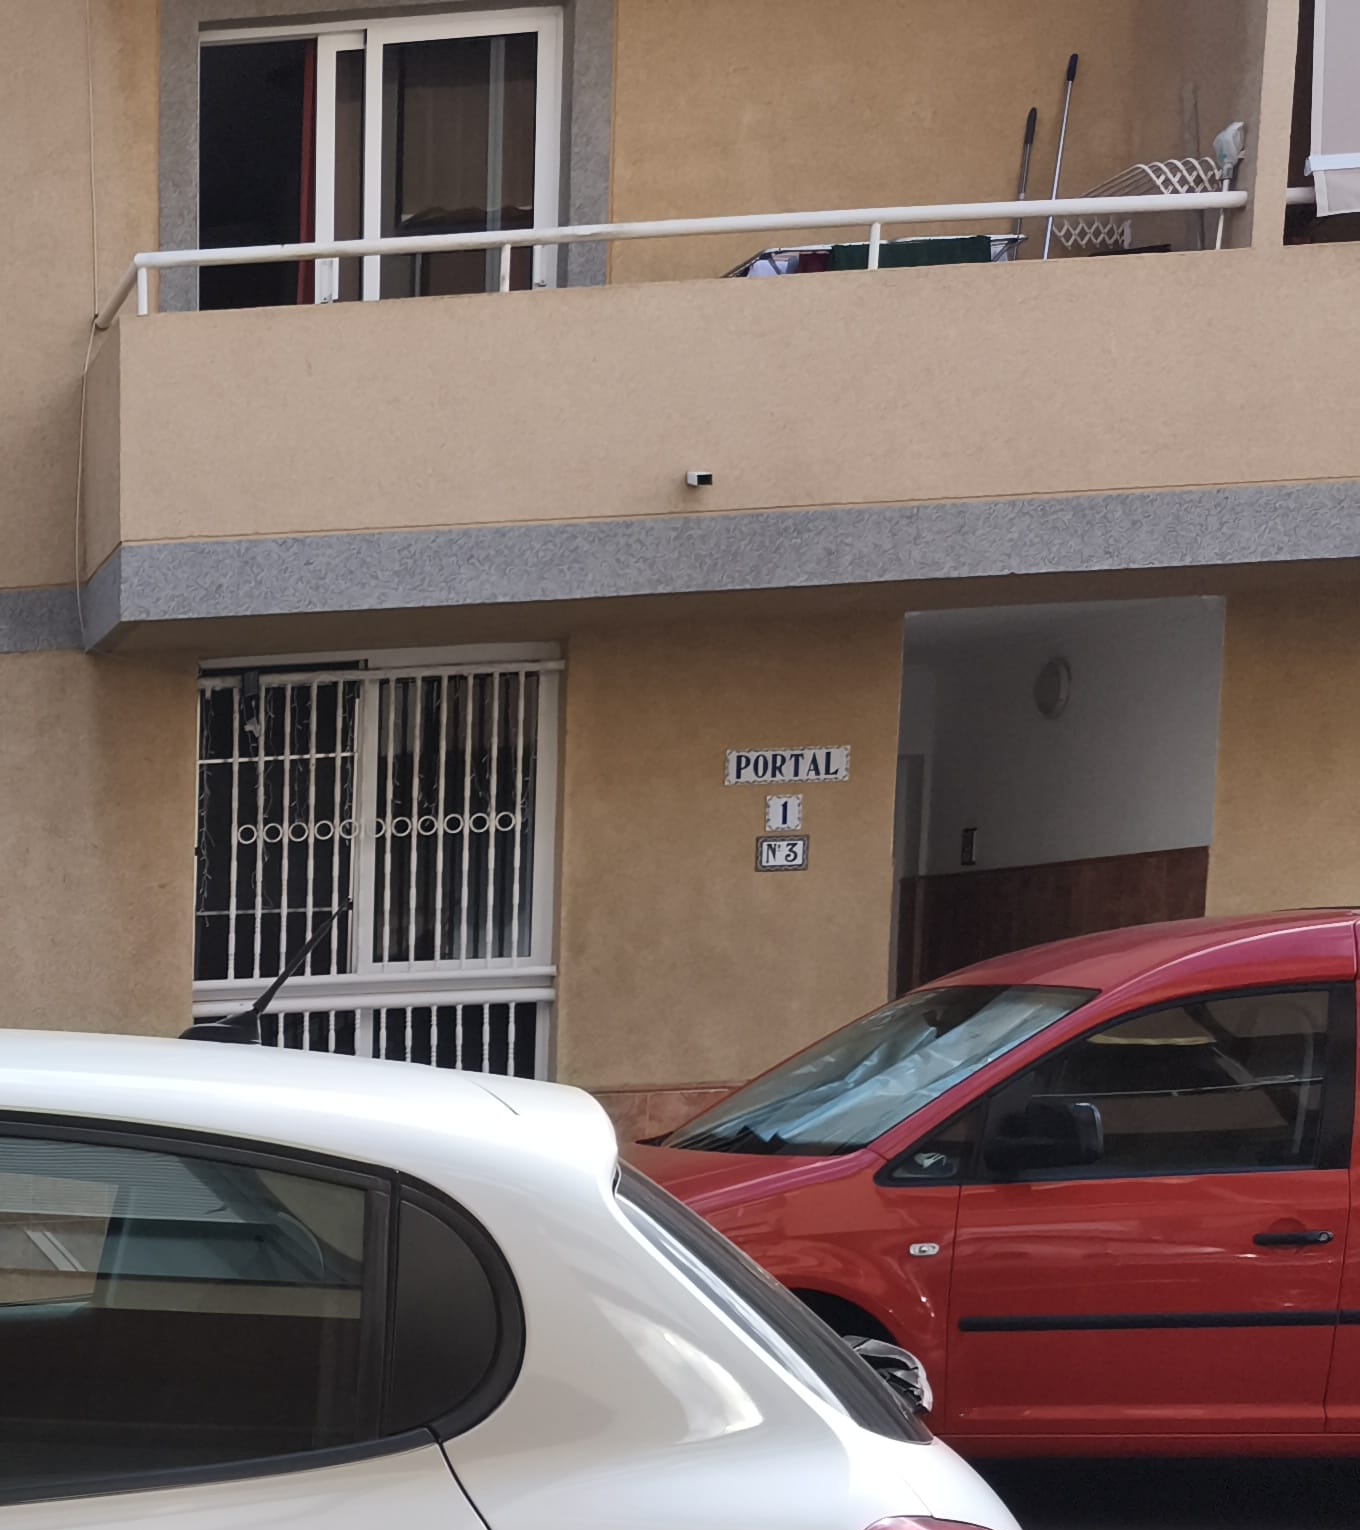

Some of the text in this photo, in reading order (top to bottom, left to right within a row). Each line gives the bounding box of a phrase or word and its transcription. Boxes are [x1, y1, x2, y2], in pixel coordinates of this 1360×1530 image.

[735, 751, 840, 780] PORTAL
[781, 800, 788, 825] 1
[784, 842, 799, 863] 3
